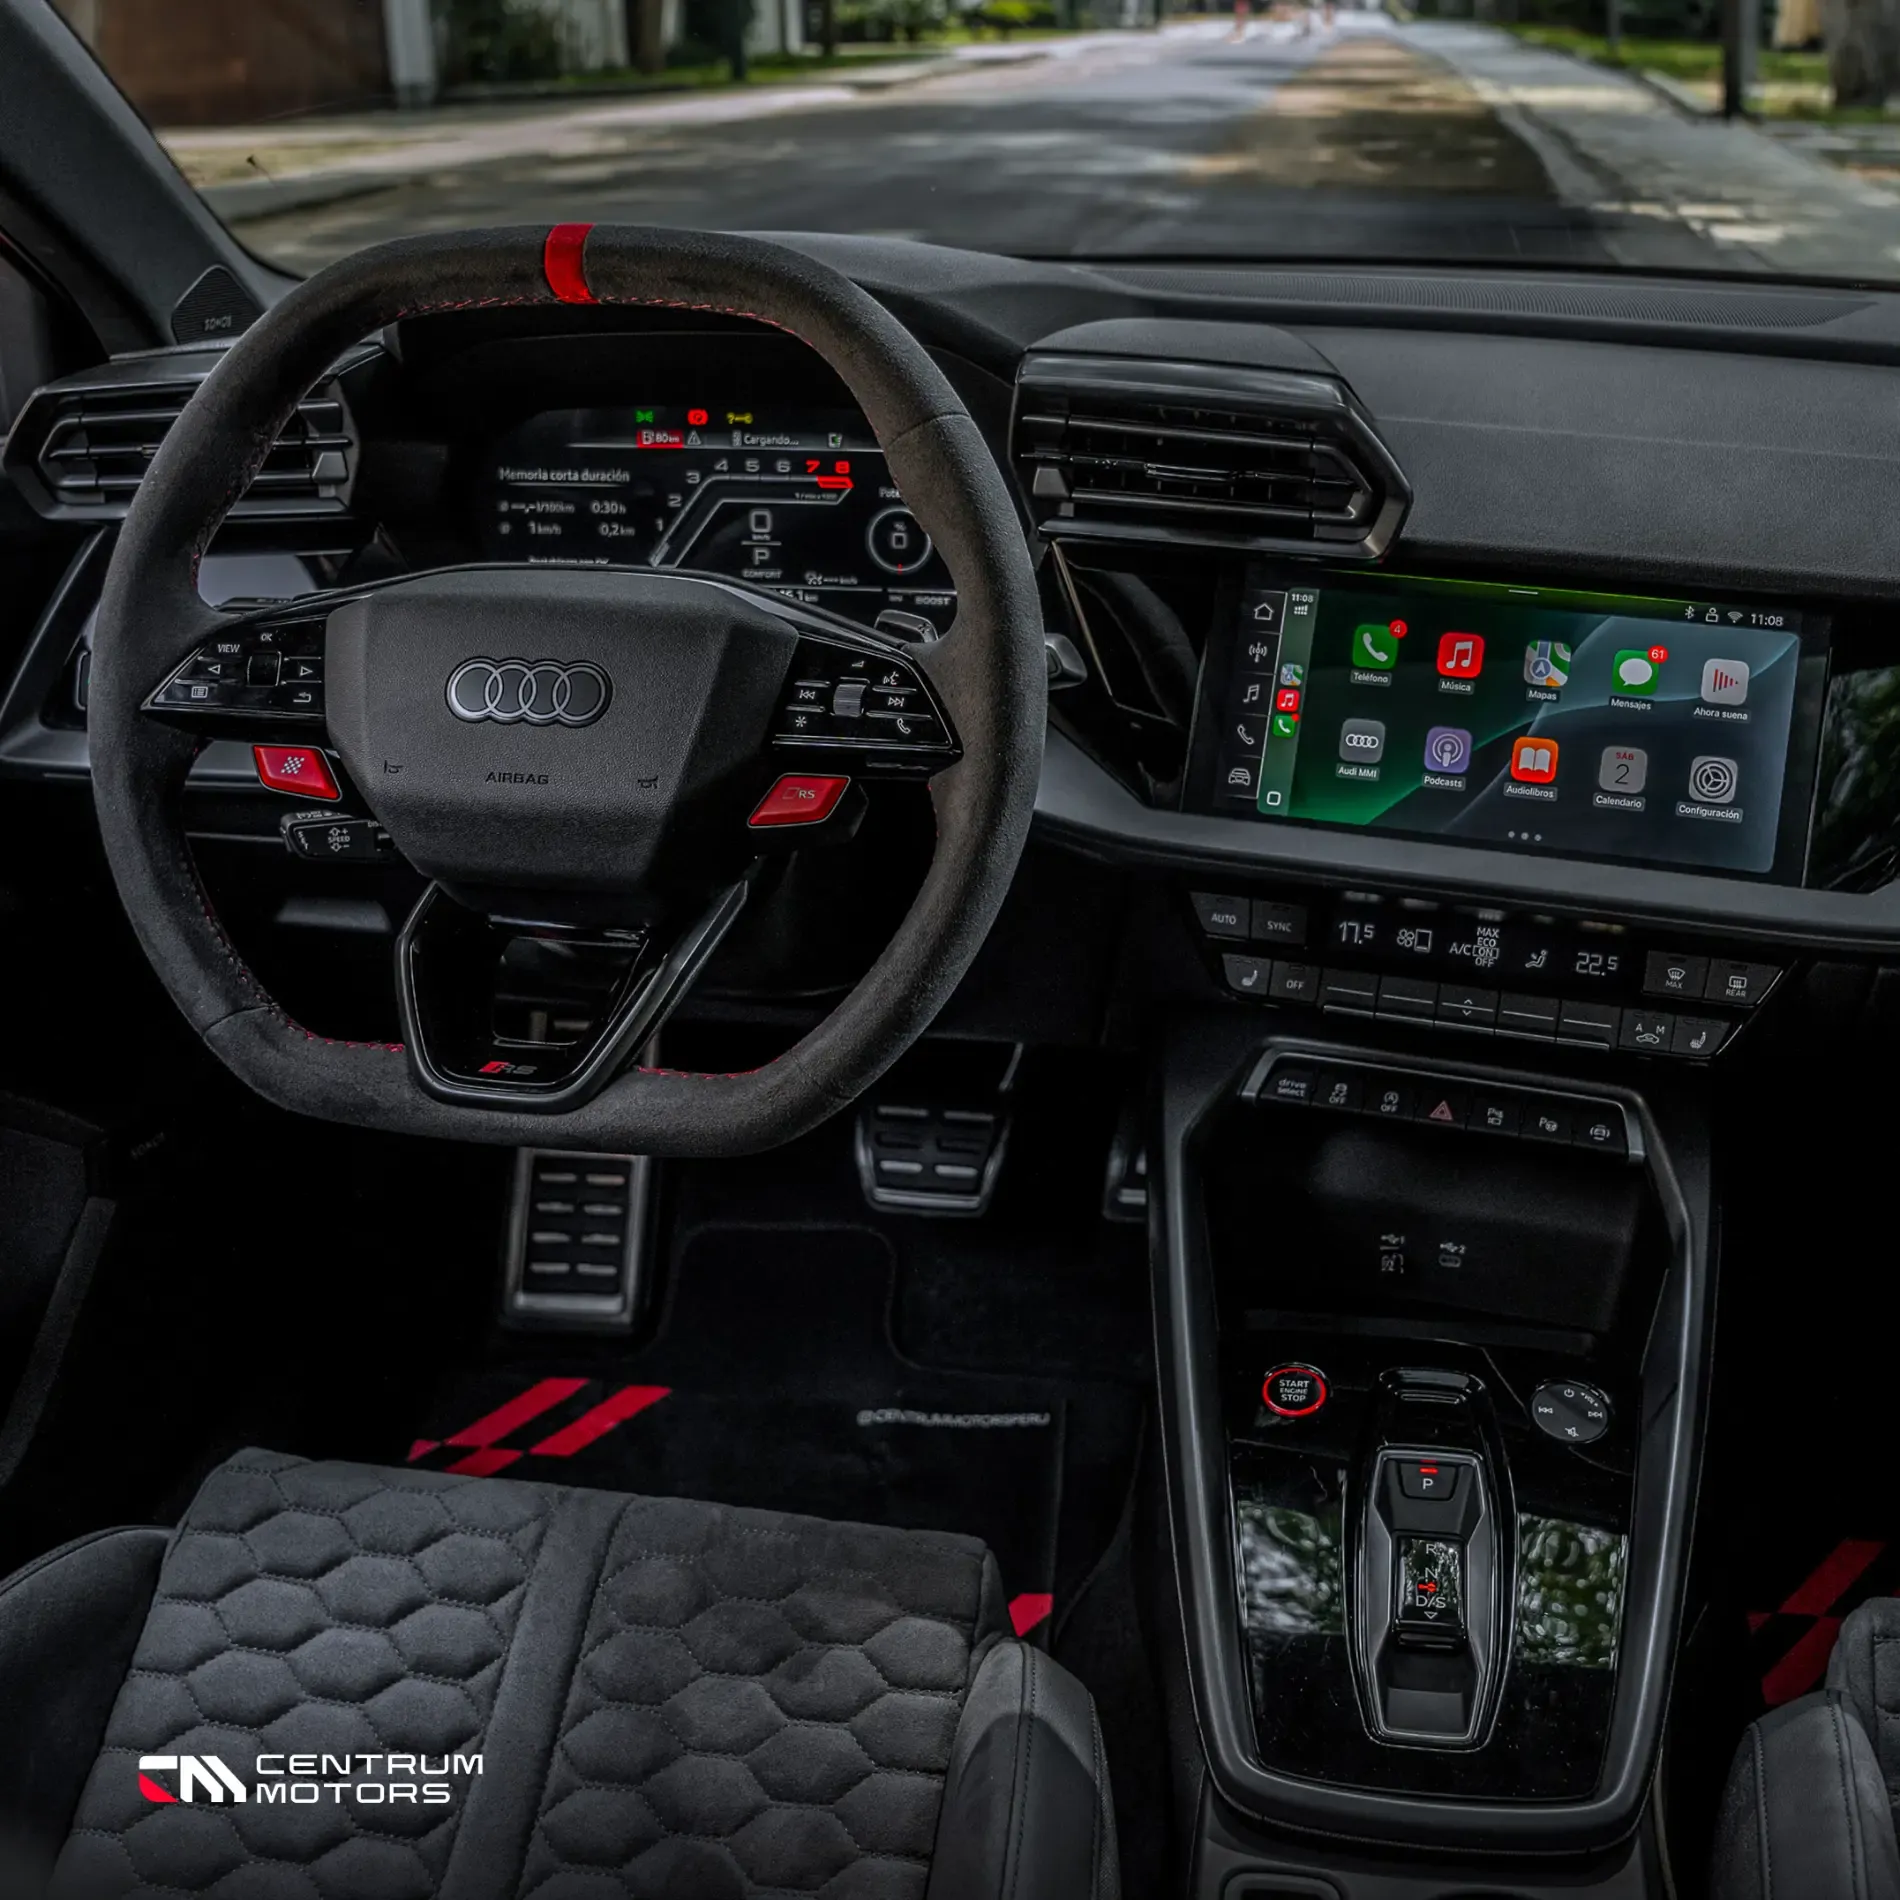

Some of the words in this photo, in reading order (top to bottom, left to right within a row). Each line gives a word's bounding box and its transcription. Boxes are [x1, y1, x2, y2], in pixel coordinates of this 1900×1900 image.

[744, 434, 799, 446] Cargando...
[714, 459, 728, 472] 4
[745, 460, 760, 472] 5
[776, 460, 790, 472] 6
[806, 460, 820, 473] 7
[835, 461, 850, 474] 8
[499, 467, 548, 480] Memoria
[550, 469, 579, 480] corta
[581, 468, 630, 482] duración
[686, 472, 700, 484] 3
[668, 495, 682, 507] 2
[656, 519, 664, 531] 1
[751, 510, 771, 532] 0
[754, 548, 770, 565] P
[1751, 614, 1783, 626] 11:08
[1394, 625, 1400, 633] 4
[260, 632, 272, 642] OK
[218, 644, 240, 653] VIEW
[1651, 650, 1664, 659] 61
[1354, 672, 1388, 683] Teléfono
[1441, 681, 1471, 692] Música
[1528, 690, 1556, 701] Mapas
[1612, 699, 1652, 710] Mensajes
[1694, 708, 1720, 718] Ahora
[1721, 711, 1748, 720] suena
[1338, 766, 1357, 776] Audi
[1358, 768, 1377, 778] MMI
[1614, 764, 1630, 784] 2
[486, 772, 549, 785] AIRBAG
[1424, 776, 1462, 788] Podcasts
[798, 790, 815, 799] RS
[1506, 786, 1554, 798] Audiolibros
[1596, 796, 1642, 808] Calendario
[1679, 805, 1740, 820] Configuración
[1212, 913, 1236, 924] AUTO
[1268, 921, 1292, 932] SYNC
[1477, 928, 1500, 938] MAX
[1477, 937, 1496, 947] ECO
[1450, 943, 1471, 955] A/C
[1478, 948, 1492, 957] ON
[1475, 958, 1494, 967] OFF
[1576, 952, 1618, 976] 22.5
[1286, 980, 1304, 990] OFF
[1666, 980, 1682, 989] MAX
[1726, 989, 1746, 997] REAR
[1636, 1024, 1642, 1032] A
[1656, 1026, 1665, 1034] M
[1278, 1078, 1306, 1088] drive
[1278, 1087, 1304, 1096] select
[1329, 1096, 1346, 1104] OFF
[1381, 1104, 1398, 1112] OFF
[1279, 1379, 1310, 1388] START
[1281, 1394, 1306, 1402] STOP
[1422, 1478, 1434, 1490] P
[1426, 1544, 1436, 1554] R
[1425, 1568, 1438, 1578] N
[1416, 1596, 1446, 1608] D/S
